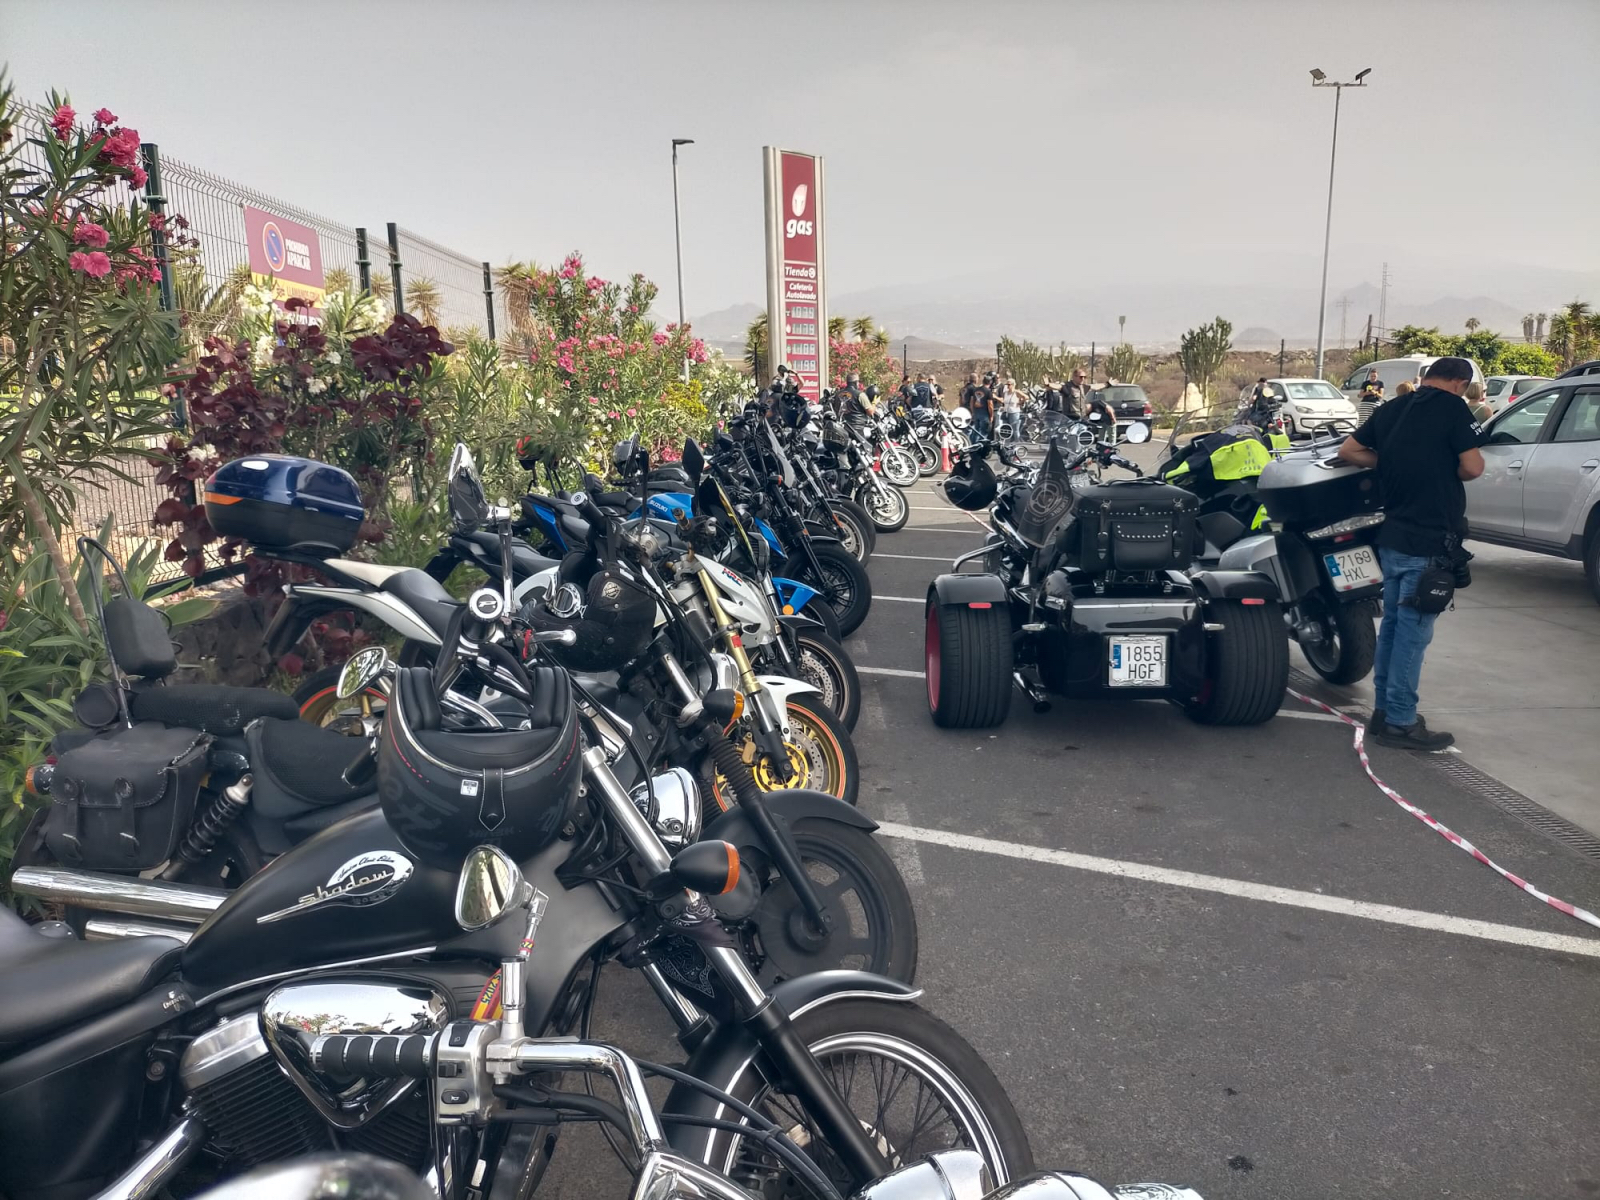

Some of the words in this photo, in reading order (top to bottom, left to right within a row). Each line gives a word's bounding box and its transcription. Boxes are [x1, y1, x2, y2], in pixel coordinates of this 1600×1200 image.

[786, 219, 813, 238] gas
[287, 251, 312, 271] APARCAR
[785, 267, 809, 277] Tienda
[786, 291, 817, 300] Autolavado
[650, 500, 668, 512] SUZUKI
[1338, 550, 1372, 569] 7169
[722, 567, 743, 587] HRC
[1343, 567, 1370, 583] HXL
[1126, 645, 1162, 662] 1855
[1128, 663, 1157, 679] HGF
[480, 981, 498, 1004] 2025
